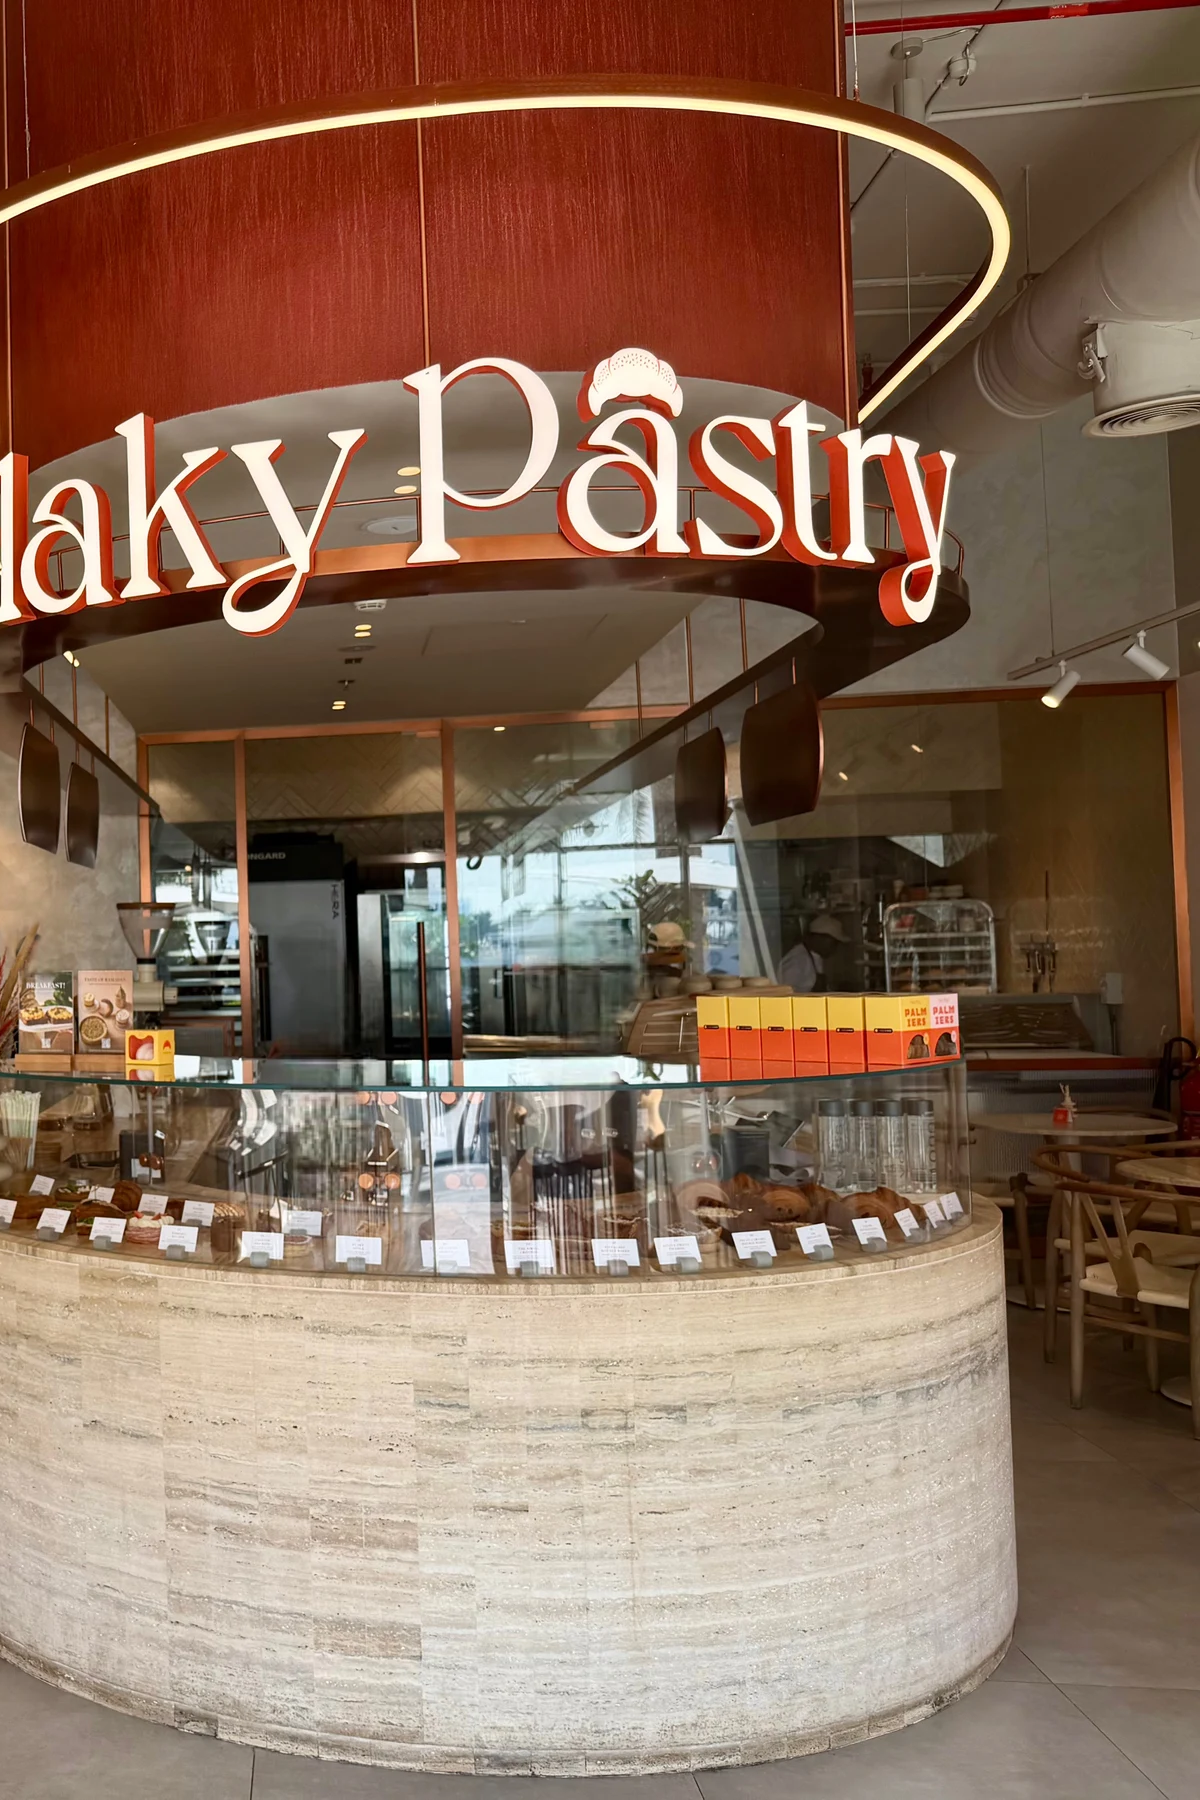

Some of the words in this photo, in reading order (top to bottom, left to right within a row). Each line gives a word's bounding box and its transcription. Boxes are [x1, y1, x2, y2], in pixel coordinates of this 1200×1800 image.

[26, 981, 66, 989] BREAKFAST!
[904, 1007, 927, 1017] PALM
[932, 1005, 955, 1015] PALM
[907, 1018, 926, 1027] IERS
[935, 1015, 954, 1025] IERS
